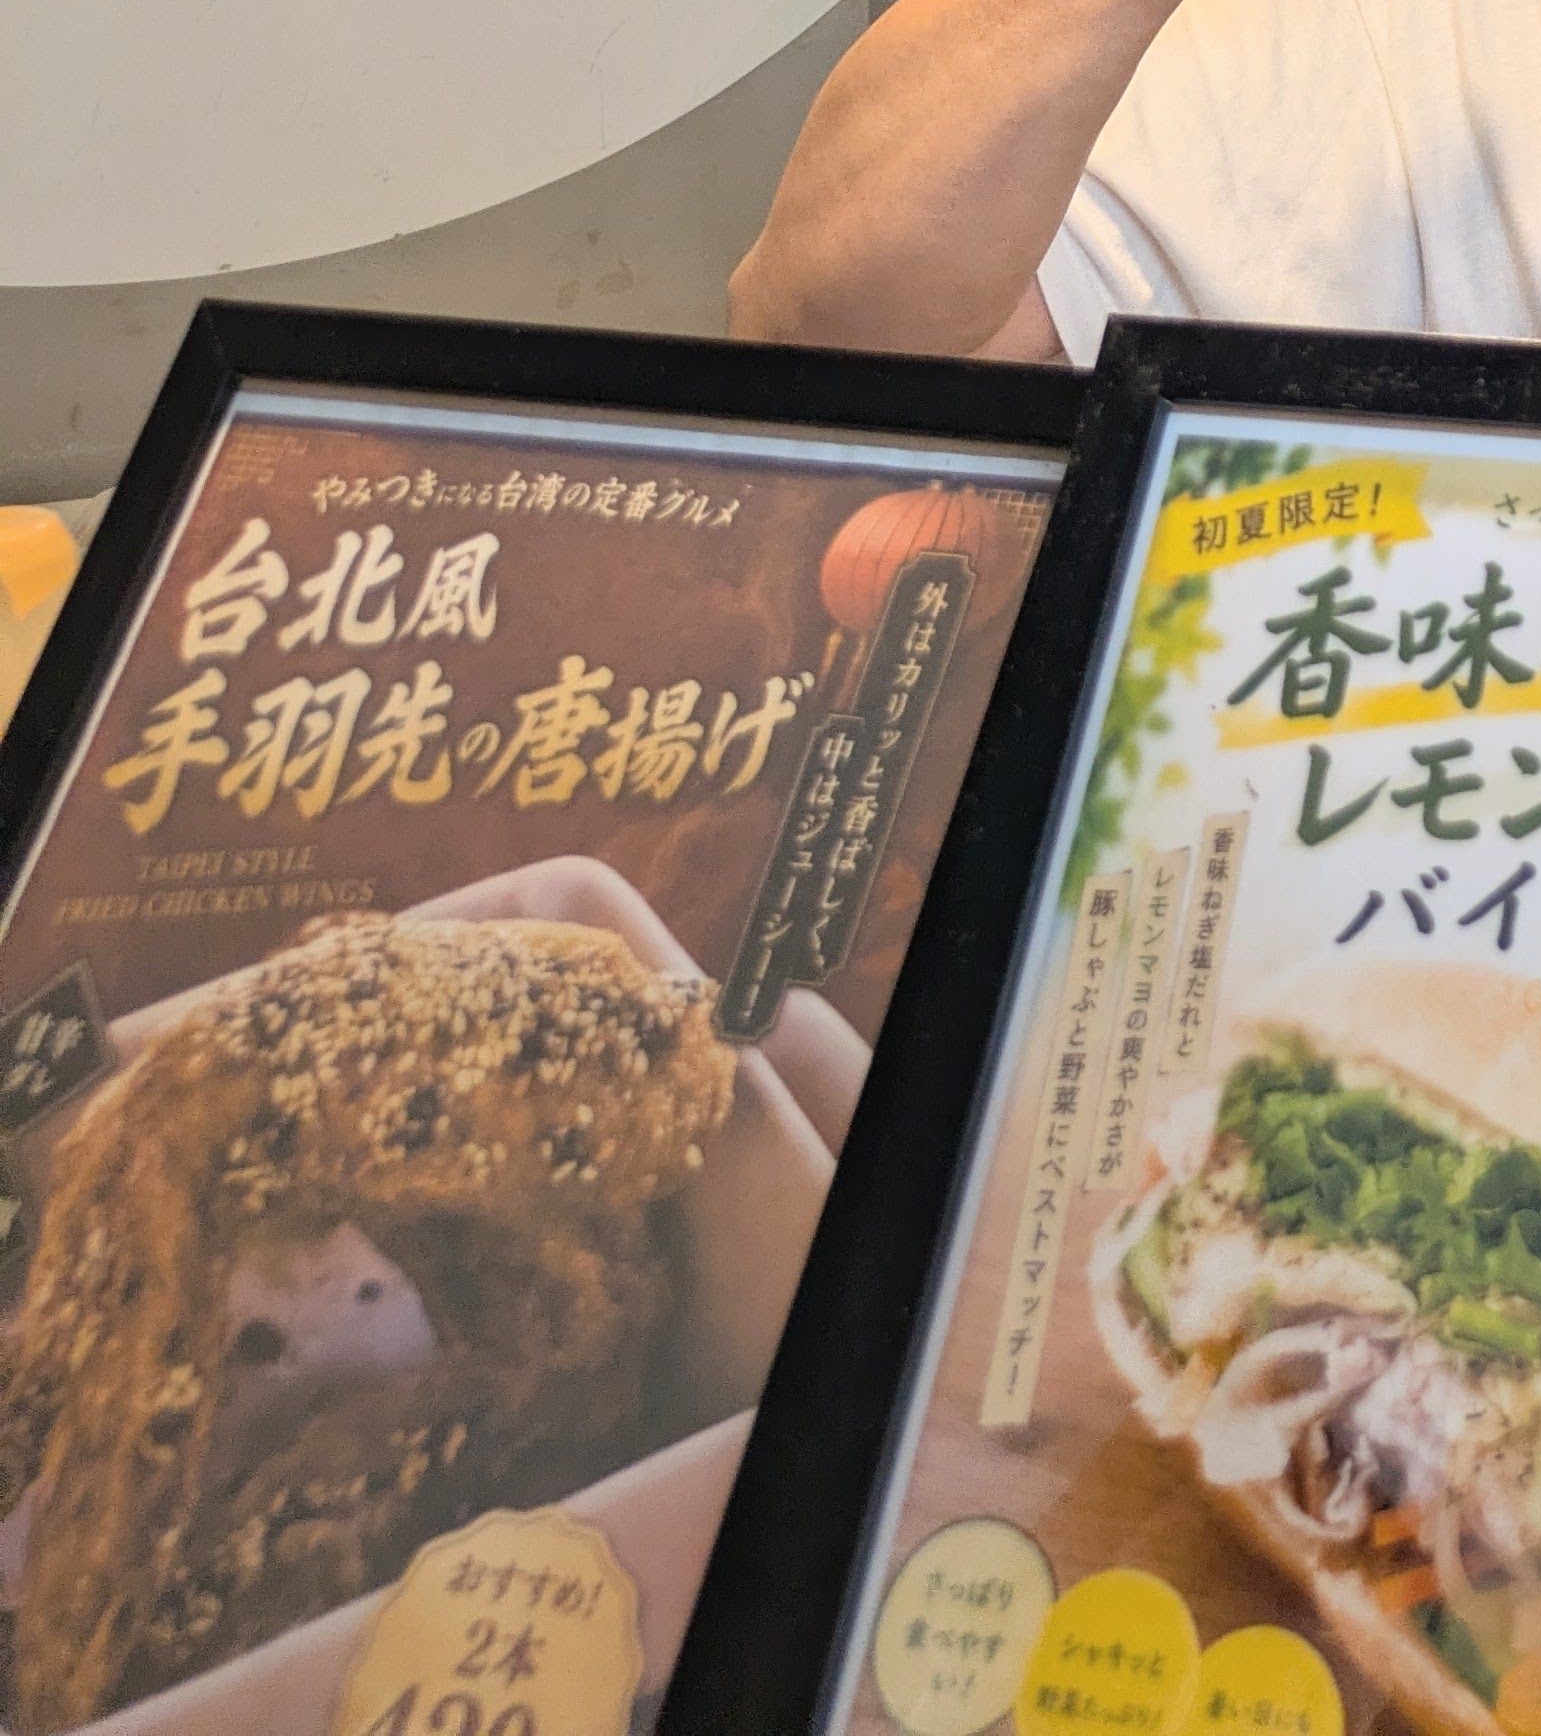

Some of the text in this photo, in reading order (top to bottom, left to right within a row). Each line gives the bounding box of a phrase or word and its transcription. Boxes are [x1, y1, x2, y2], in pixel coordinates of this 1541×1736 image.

[312, 466, 742, 527] やみつきになる台湾の定番グルメ
[181, 518, 500, 661] 台北風
[102, 654, 815, 836] 手羽先の唐揚げ
